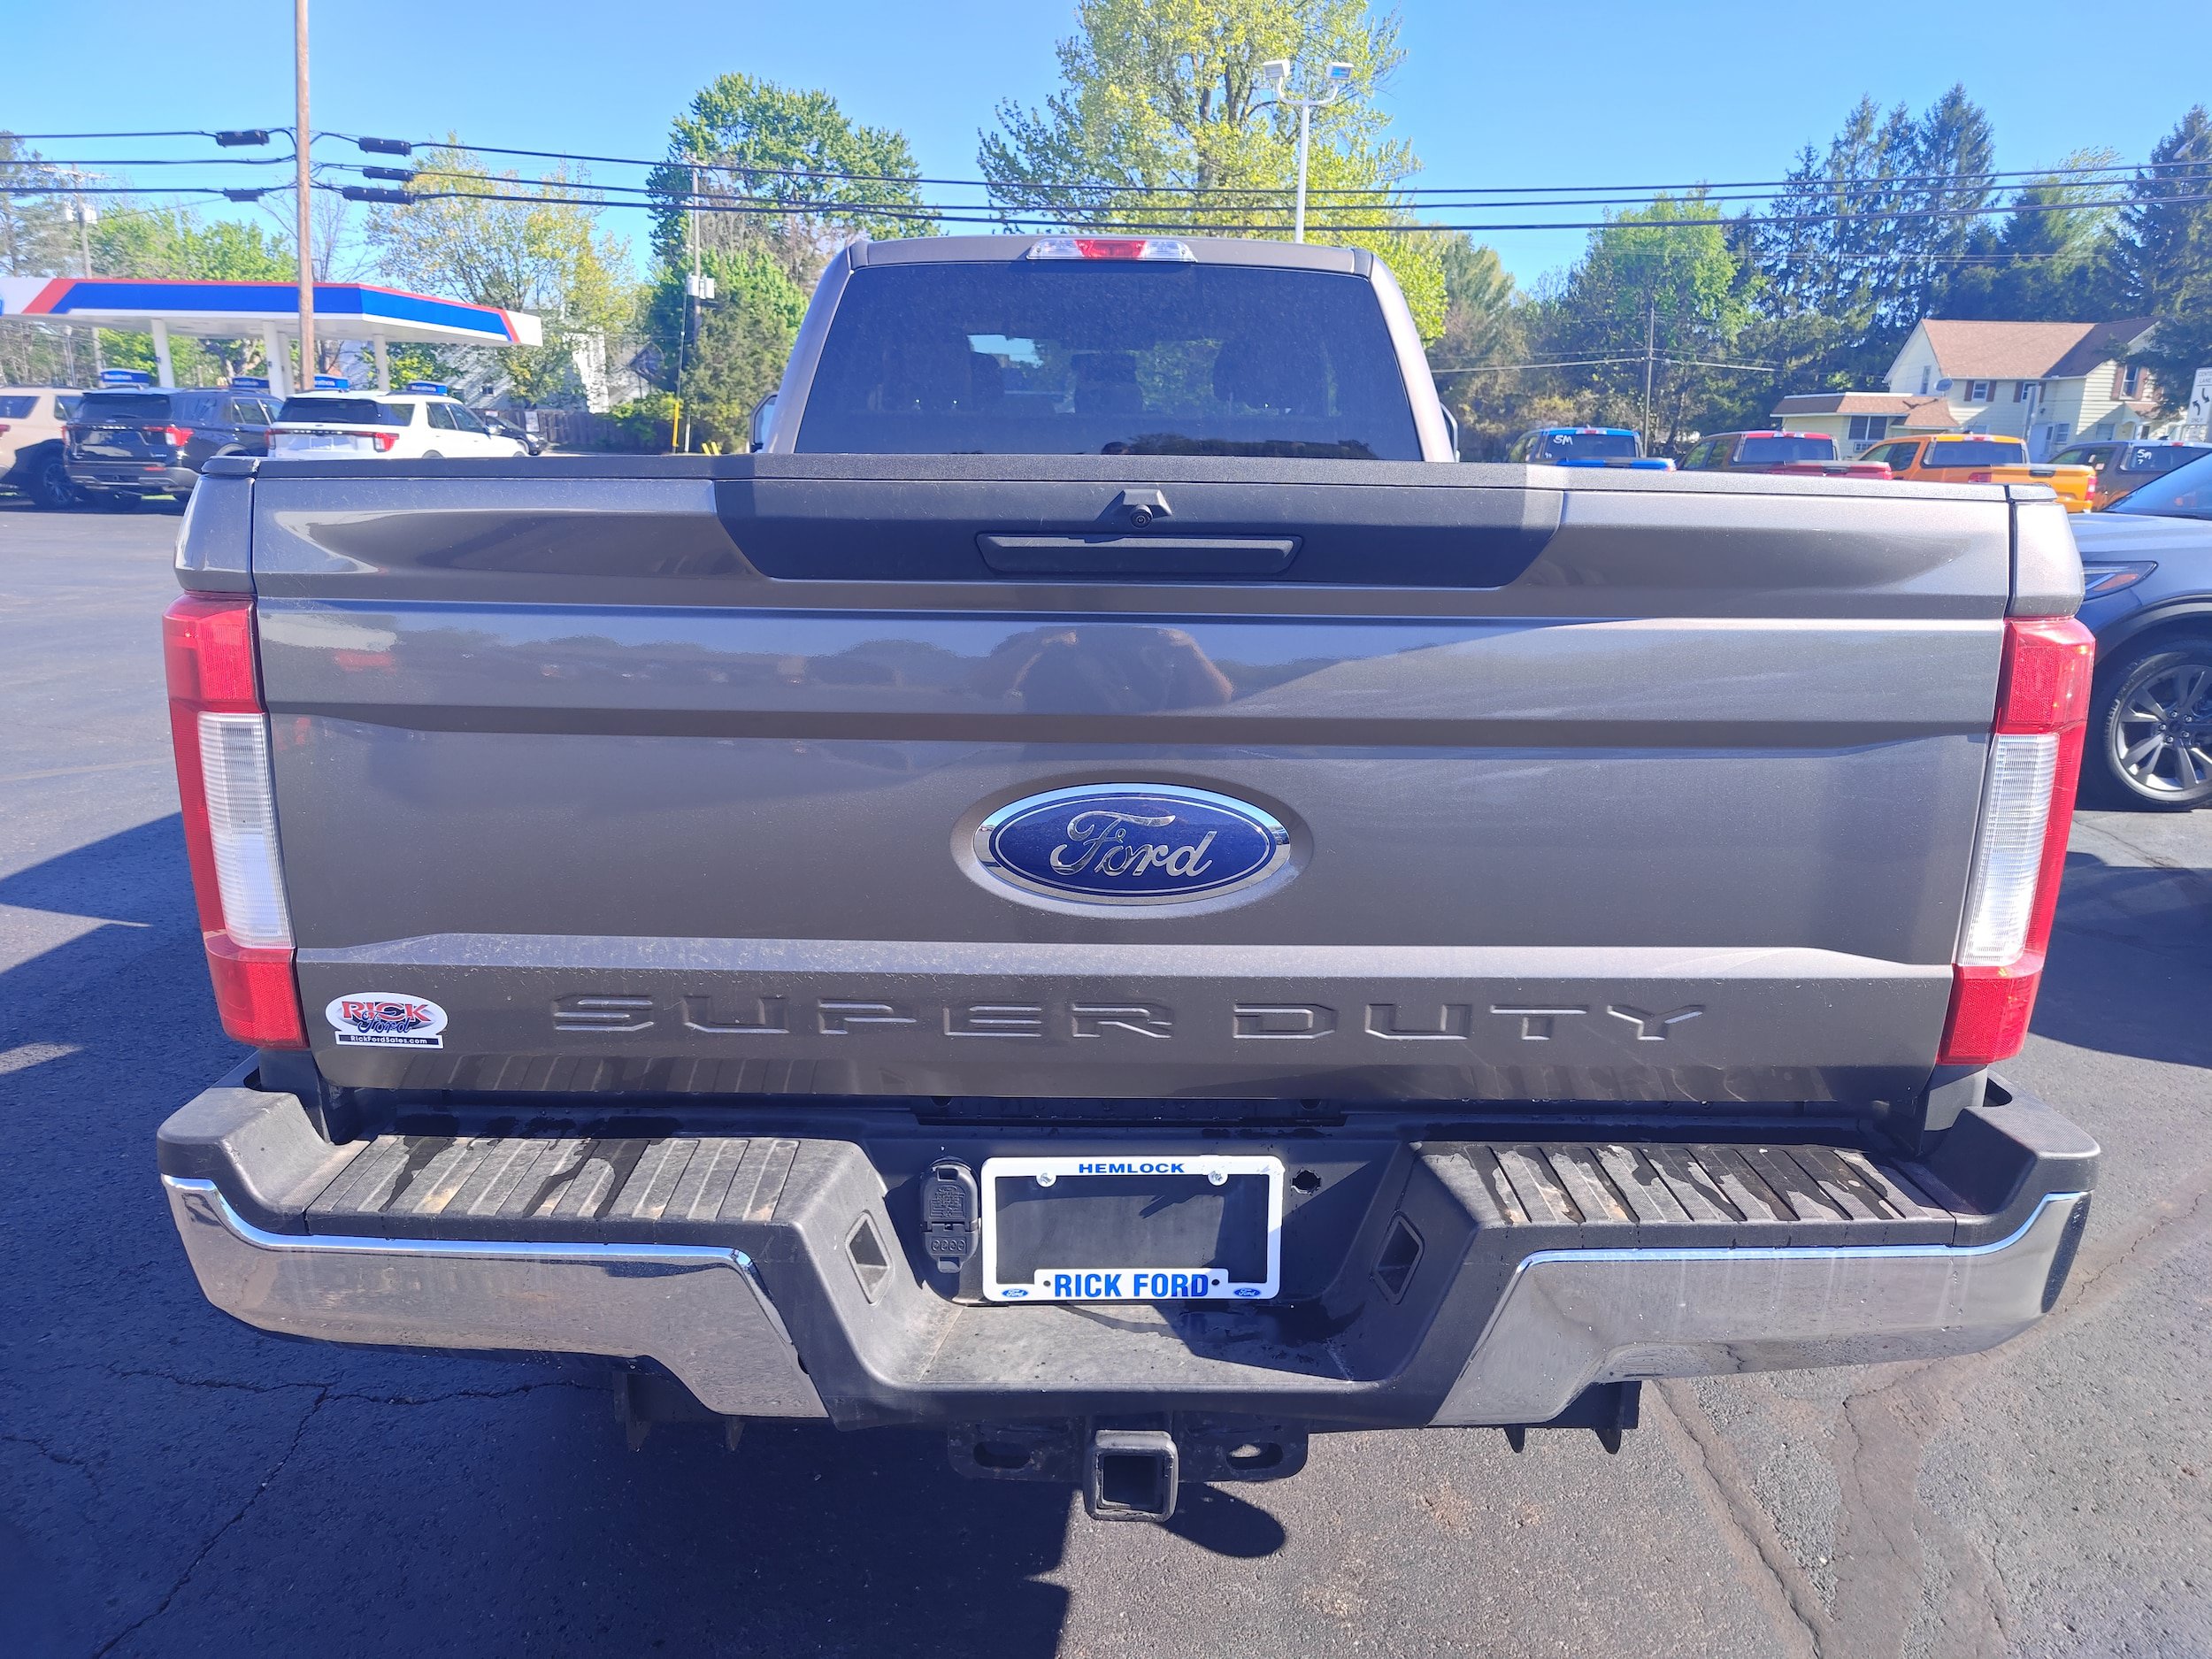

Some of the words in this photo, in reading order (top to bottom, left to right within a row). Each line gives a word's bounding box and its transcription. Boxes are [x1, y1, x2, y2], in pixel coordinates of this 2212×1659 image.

[1049, 810, 1218, 878] Ford
[342, 1001, 432, 1022] RICK
[357, 1010, 412, 1033] Ford
[552, 995, 1173, 1039] SUPER
[1233, 1003, 1706, 1041] DUTY
[350, 1034, 428, 1045] RickFordSales.com
[1079, 1163, 1186, 1173] HEMLOCK
[1055, 1273, 1122, 1297] RICK
[1133, 1273, 1210, 1297] FORD
